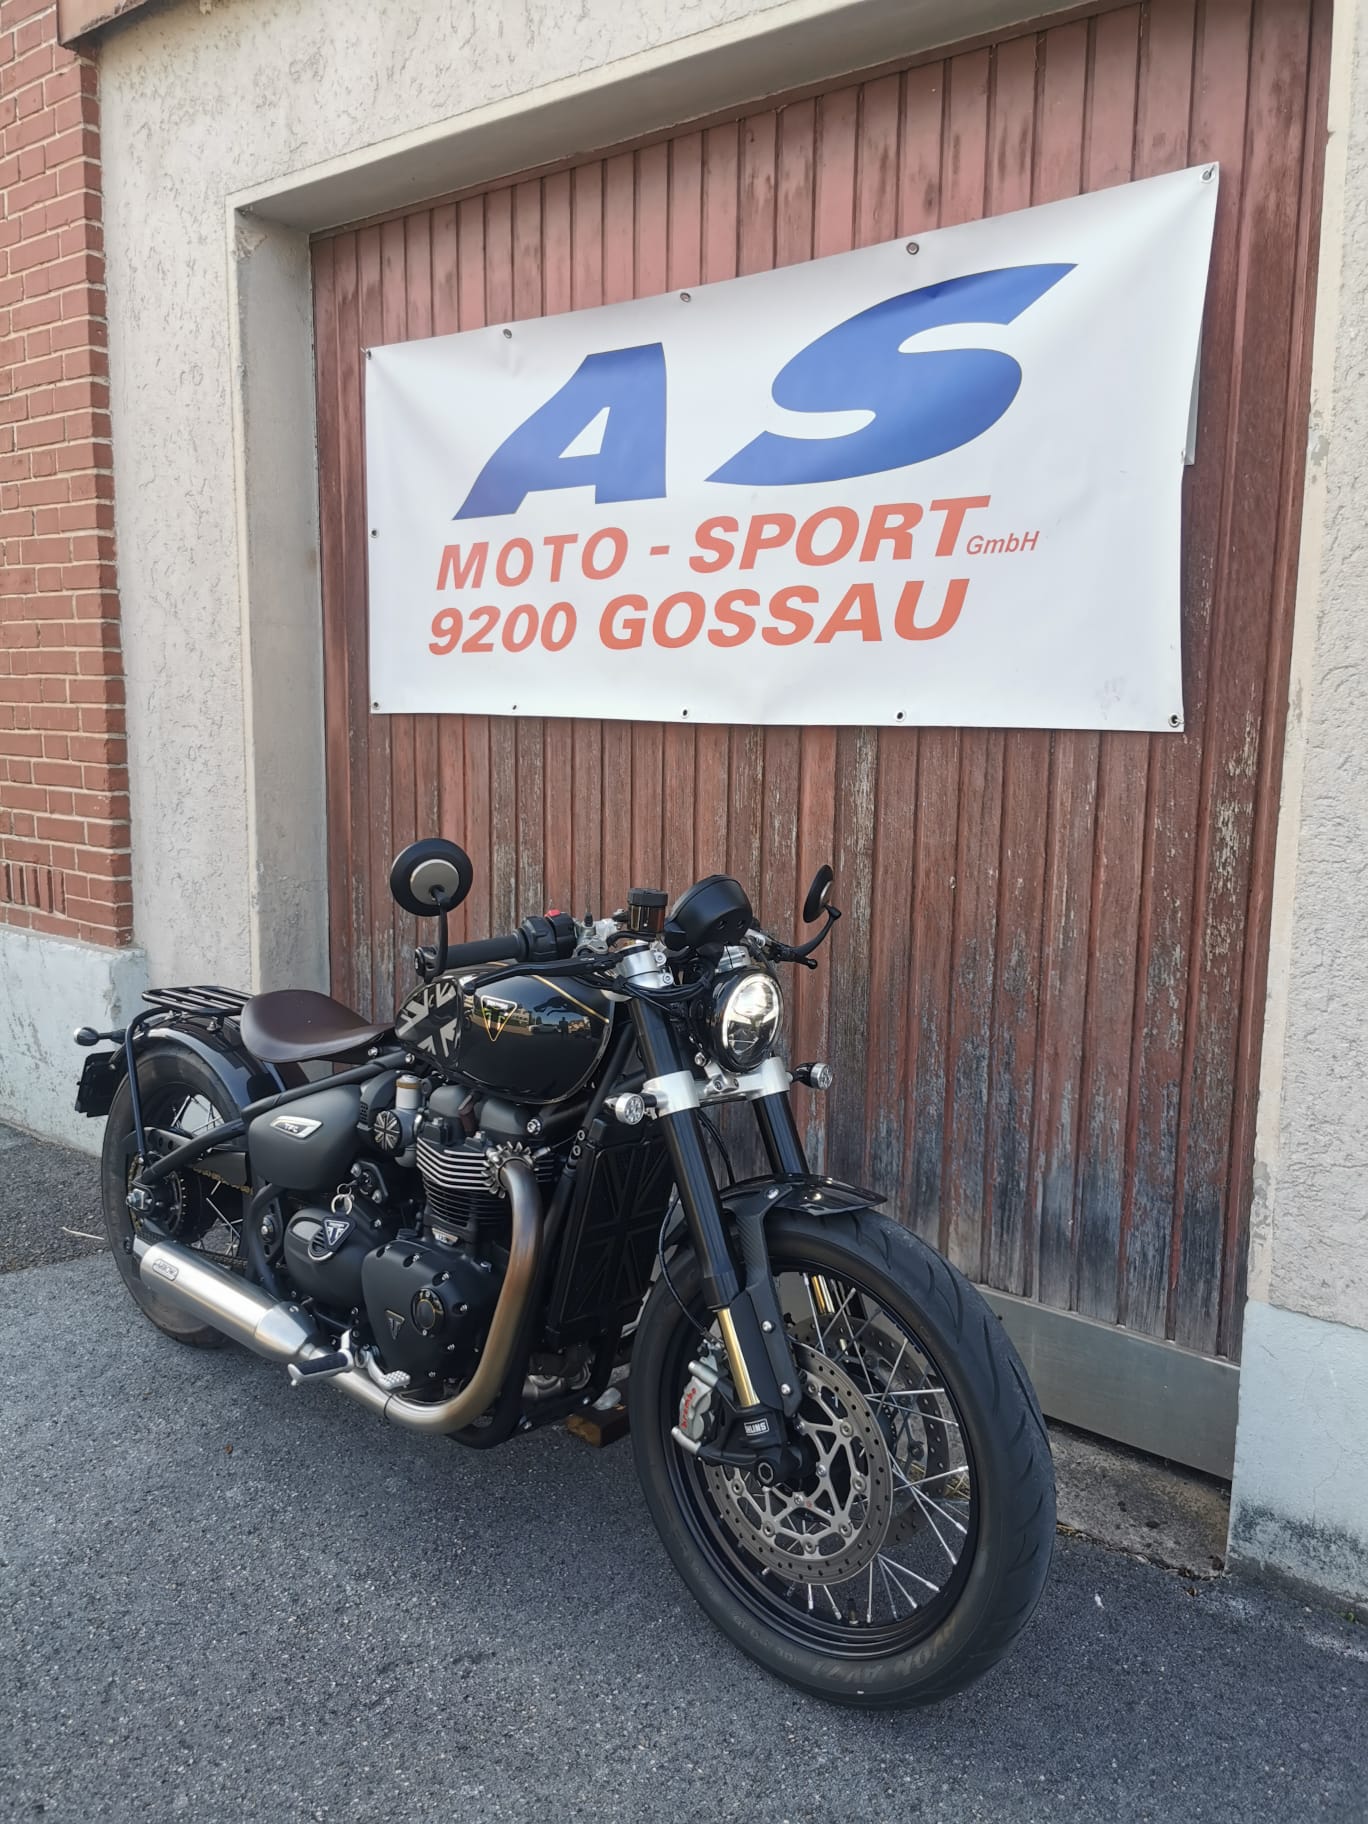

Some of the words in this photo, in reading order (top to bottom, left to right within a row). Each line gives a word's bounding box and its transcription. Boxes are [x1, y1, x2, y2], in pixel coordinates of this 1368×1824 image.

[437, 528, 628, 590] MOTO
[690, 496, 991, 573] SPORT
[966, 530, 1039, 556] GmbH
[429, 602, 577, 656] 9200
[600, 579, 969, 651] GOSSAU
